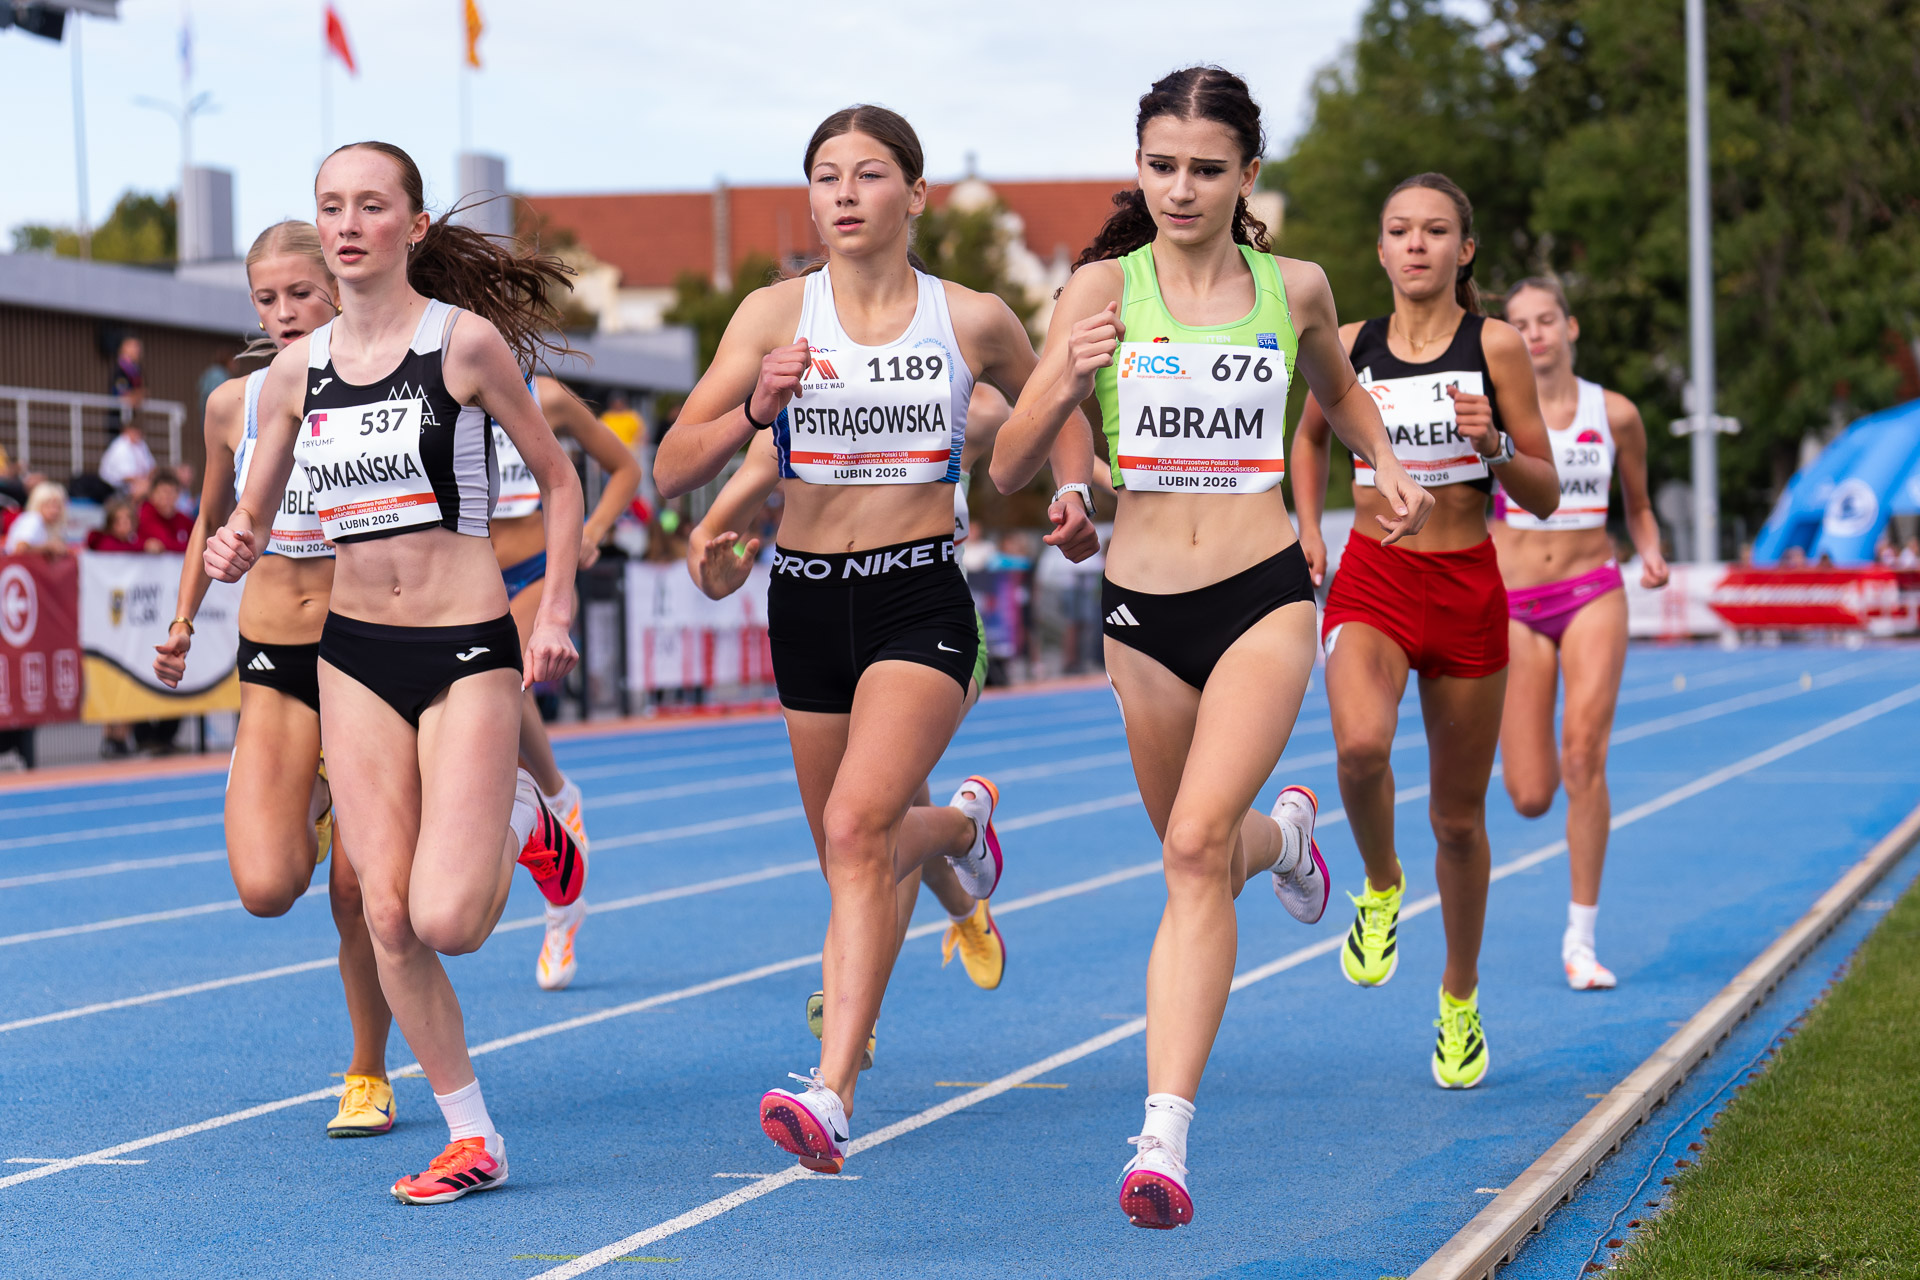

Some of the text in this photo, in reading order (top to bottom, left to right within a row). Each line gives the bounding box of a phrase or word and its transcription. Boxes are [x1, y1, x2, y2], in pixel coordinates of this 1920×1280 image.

[867, 355, 943, 383] 1189
[1211, 354, 1273, 383] 676
[359, 407, 408, 436] 537
[793, 403, 946, 442] PSTRĄGOWSKA
[1135, 405, 1264, 440] ABRAM
[1386, 421, 1466, 446] AŁEK
[302, 438, 335, 448] TRYUMF
[1565, 448, 1600, 467] 230
[834, 467, 907, 479] LUBIN 2026
[1158, 475, 1237, 488] LUBIN 2026
[339, 513, 400, 531] LUBIN 2026
[842, 543, 935, 579] NIKE
